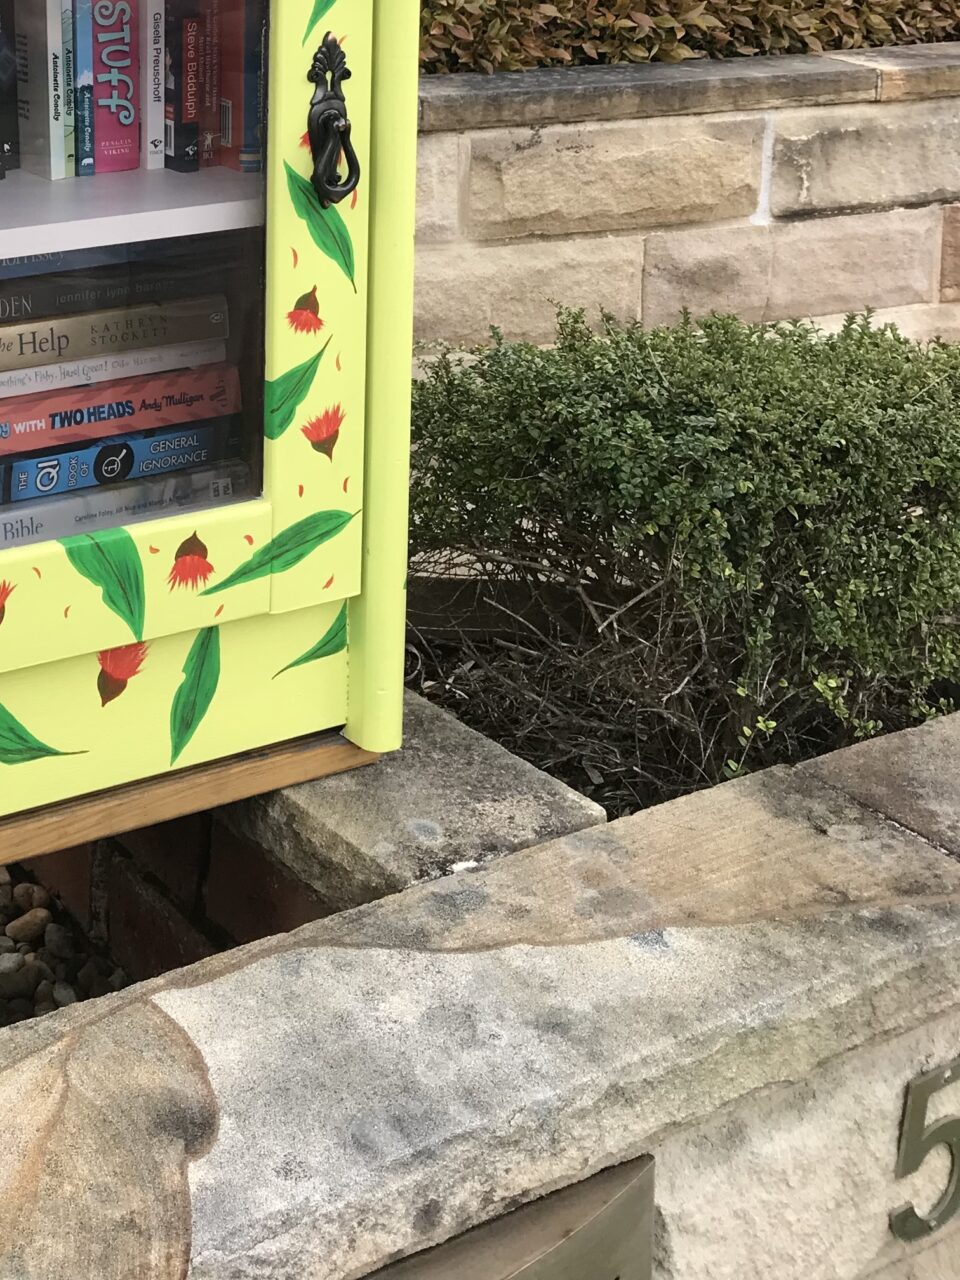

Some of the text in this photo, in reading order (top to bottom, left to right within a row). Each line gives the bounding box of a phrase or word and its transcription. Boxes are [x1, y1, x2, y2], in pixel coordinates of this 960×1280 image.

[52, 52, 60, 92] Antoinette
[65, 47, 73, 87] Antoinette
[152, 12, 162, 102] Gisela Preuschoff
[184, 22, 198, 119] Steve Biddulph
[90, 314, 169, 334] KATHRYN
[90, 326, 169, 346] STOCKETT
[17, 326, 70, 357] Help
[13, 418, 47, 435] WITH
[49, 408, 86, 430] TWO
[86, 399, 136, 425] HEADS
[140, 397, 162, 413] Andy
[162, 391, 205, 408] Mulligan
[139, 448, 209, 473] IGNORANCE
[150, 433, 200, 455] GENERAL
[18, 456, 79, 492] THE QI BOOK
[80, 463, 89, 478] OF
[3, 516, 44, 541] Bible
[888, 1053, 960, 1243] 5
